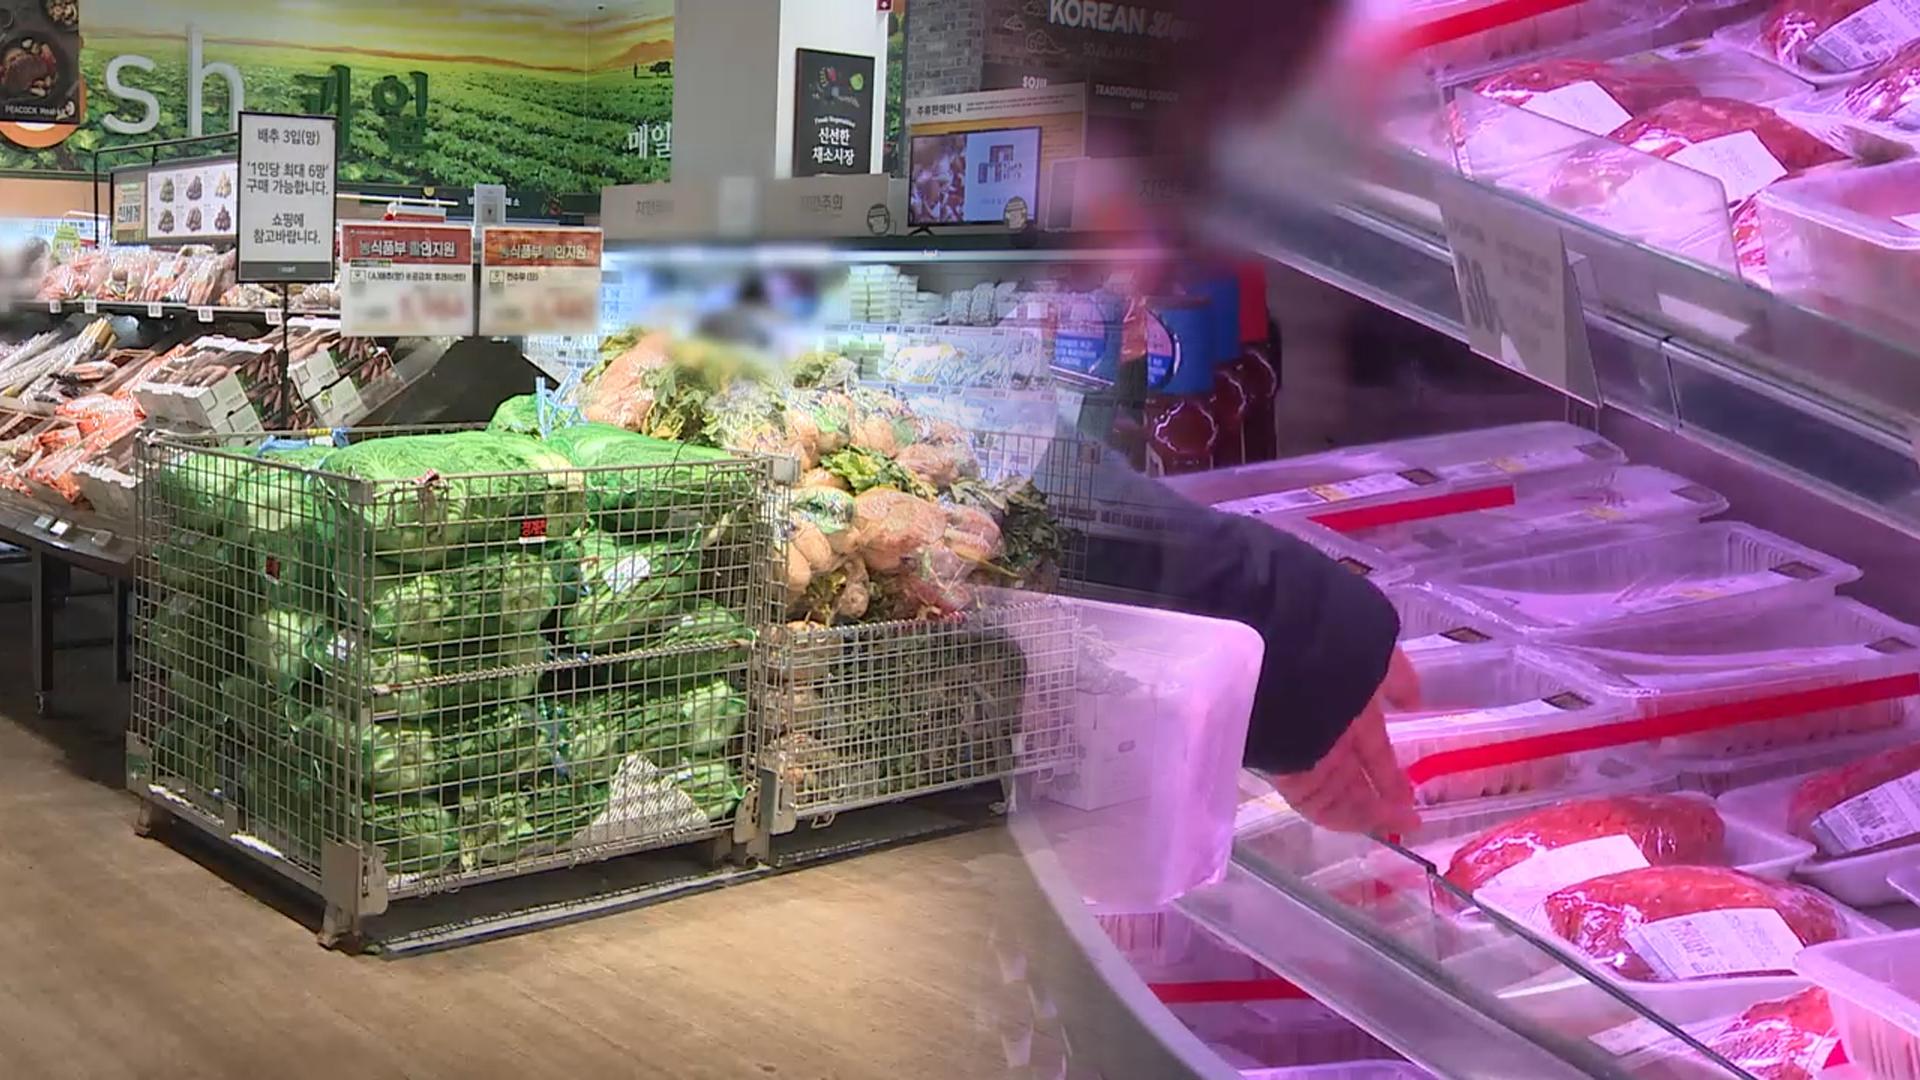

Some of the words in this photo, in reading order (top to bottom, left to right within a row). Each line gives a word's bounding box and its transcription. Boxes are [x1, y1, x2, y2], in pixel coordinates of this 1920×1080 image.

[1049, 0, 1145, 35] KOREAN
[257, 128, 280, 144] 배추
[283, 129, 321, 146] 3입(망)
[628, 123, 671, 160] 매일
[818, 127, 851, 146] 신선한
[811, 146, 855, 166] 채소시장
[284, 163, 305, 178] 최대
[246, 179, 269, 195] 구매
[272, 180, 329, 196] 가능합니다.
[272, 213, 305, 229] 쇼핑에
[254, 228, 321, 245] 참고바랍니다.
[500, 243, 542, 260] 식품부
[544, 244, 587, 260] 인지원
